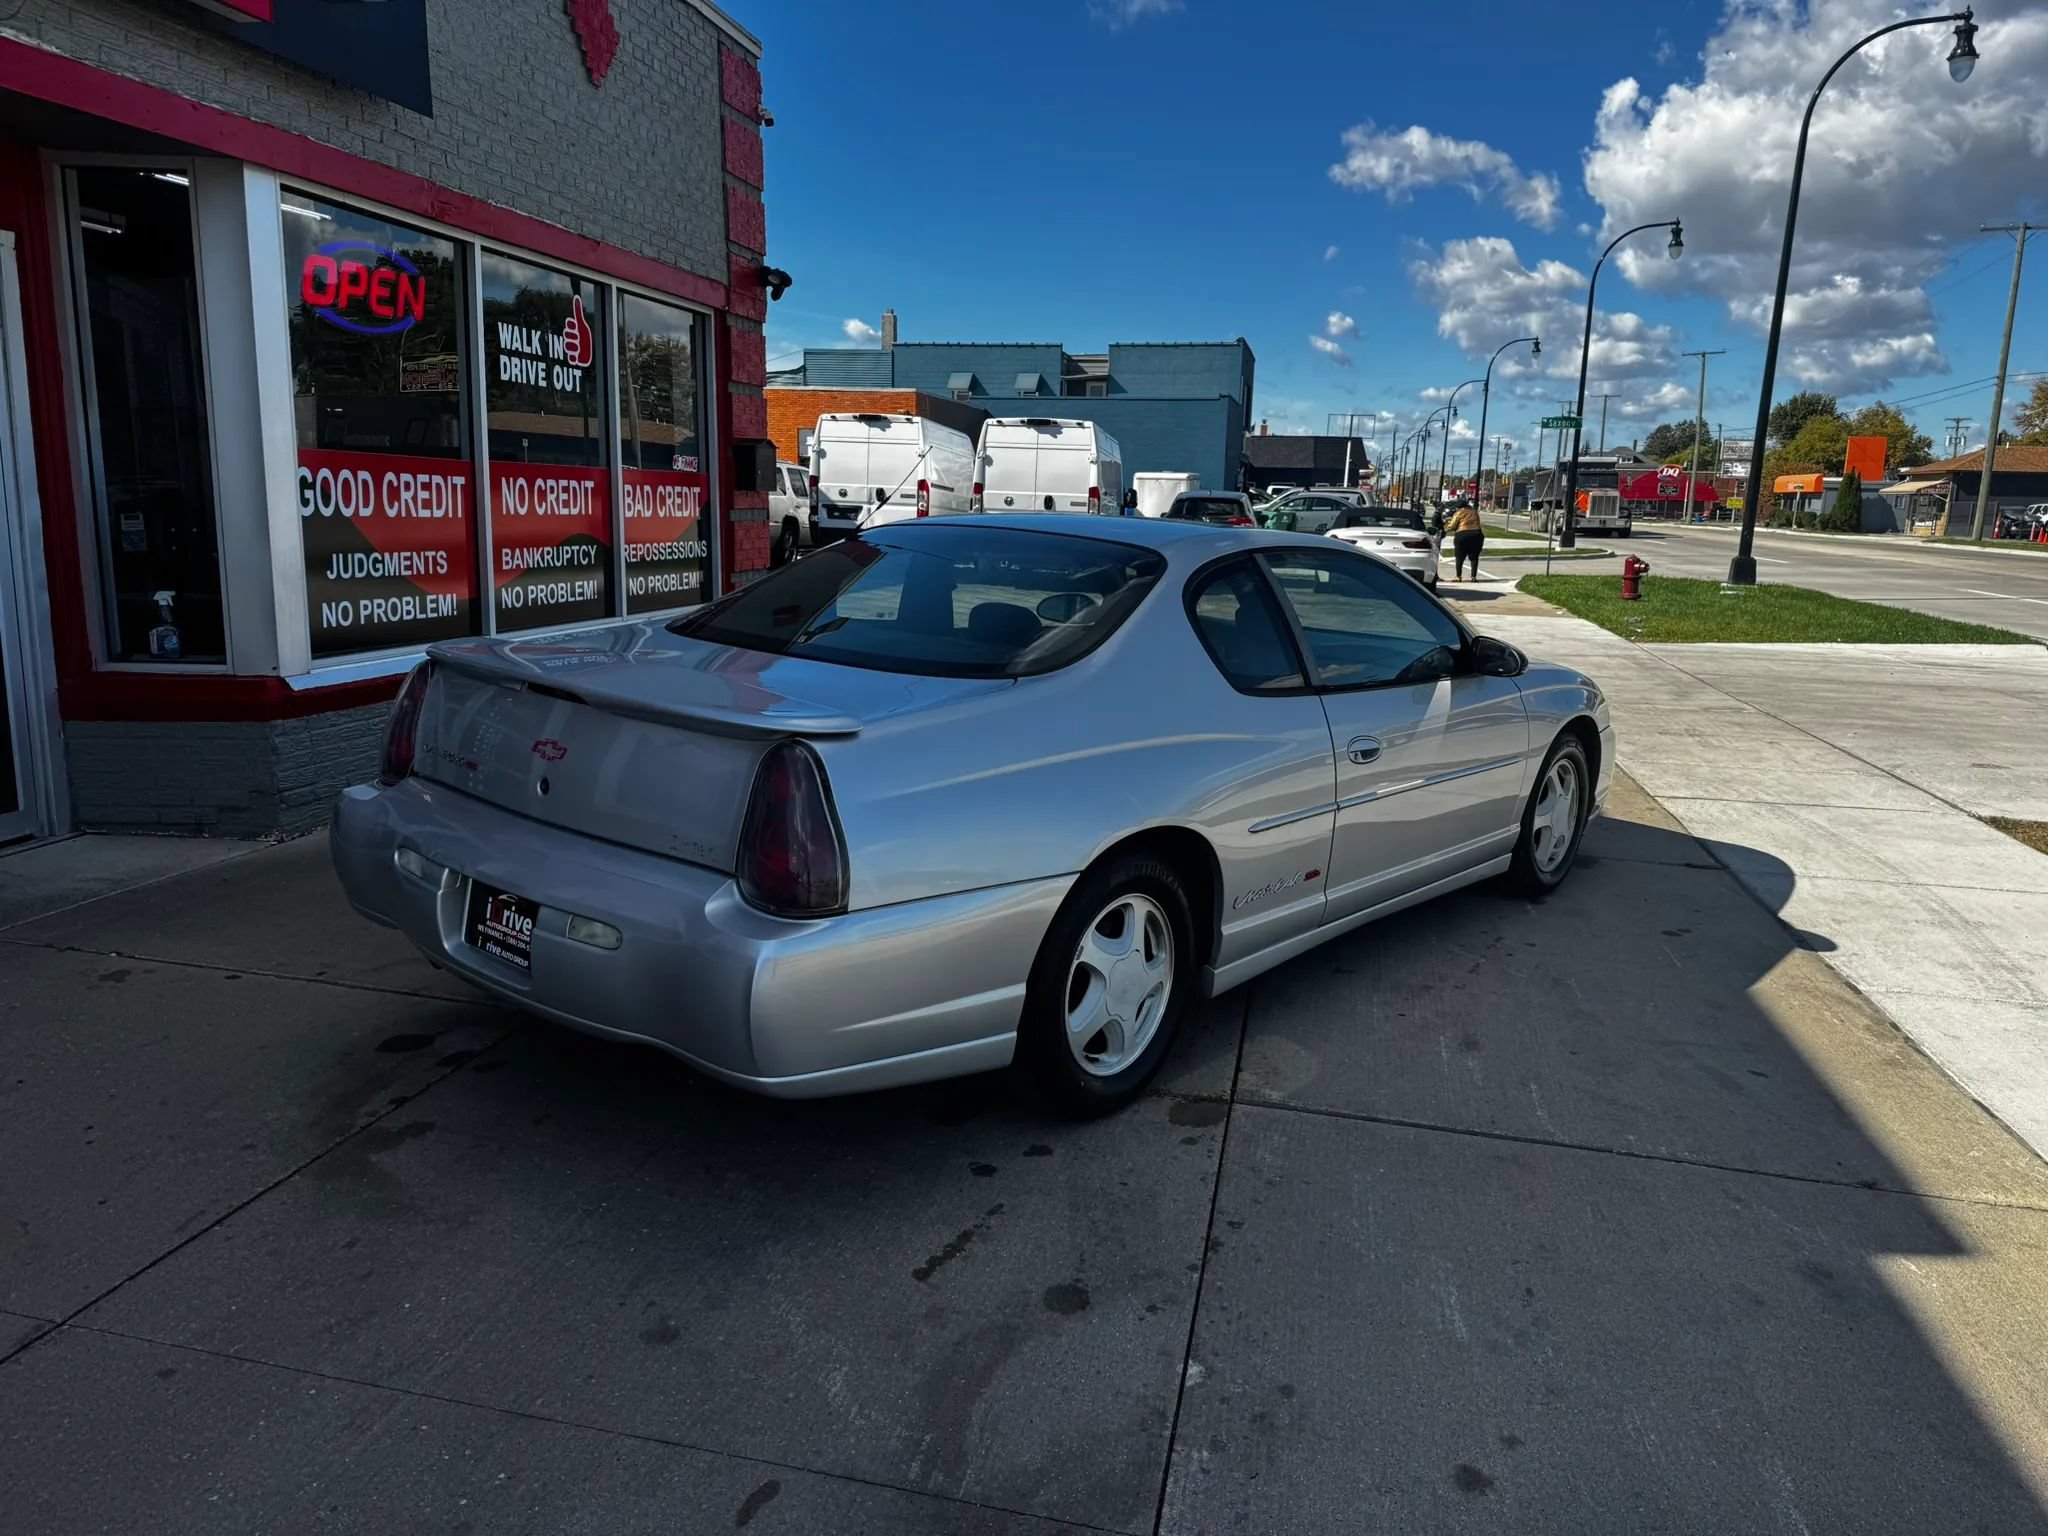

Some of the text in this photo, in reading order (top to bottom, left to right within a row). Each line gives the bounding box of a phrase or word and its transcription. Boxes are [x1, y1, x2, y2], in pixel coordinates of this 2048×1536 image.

[301, 254, 427, 321] OPEN
[498, 321, 564, 360] WALK IN
[500, 354, 582, 393] DRIVE OUT
[1548, 419, 1576, 428] Saxony
[1662, 467, 1680, 478] DQ
[298, 466, 466, 519] GOOD CREDIT
[501, 476, 595, 516] NO CREDIT
[624, 484, 701, 518] BAD CREDIT
[326, 550, 448, 580] JUDGMENTS
[502, 545, 597, 571] BANKRUPTCY
[624, 540, 707, 563] REPOSSESSIONS
[501, 580, 598, 608] NO PROBLEM!
[628, 571, 700, 596] NO PROBLEM!
[322, 593, 457, 628] NO PROBLEM!
